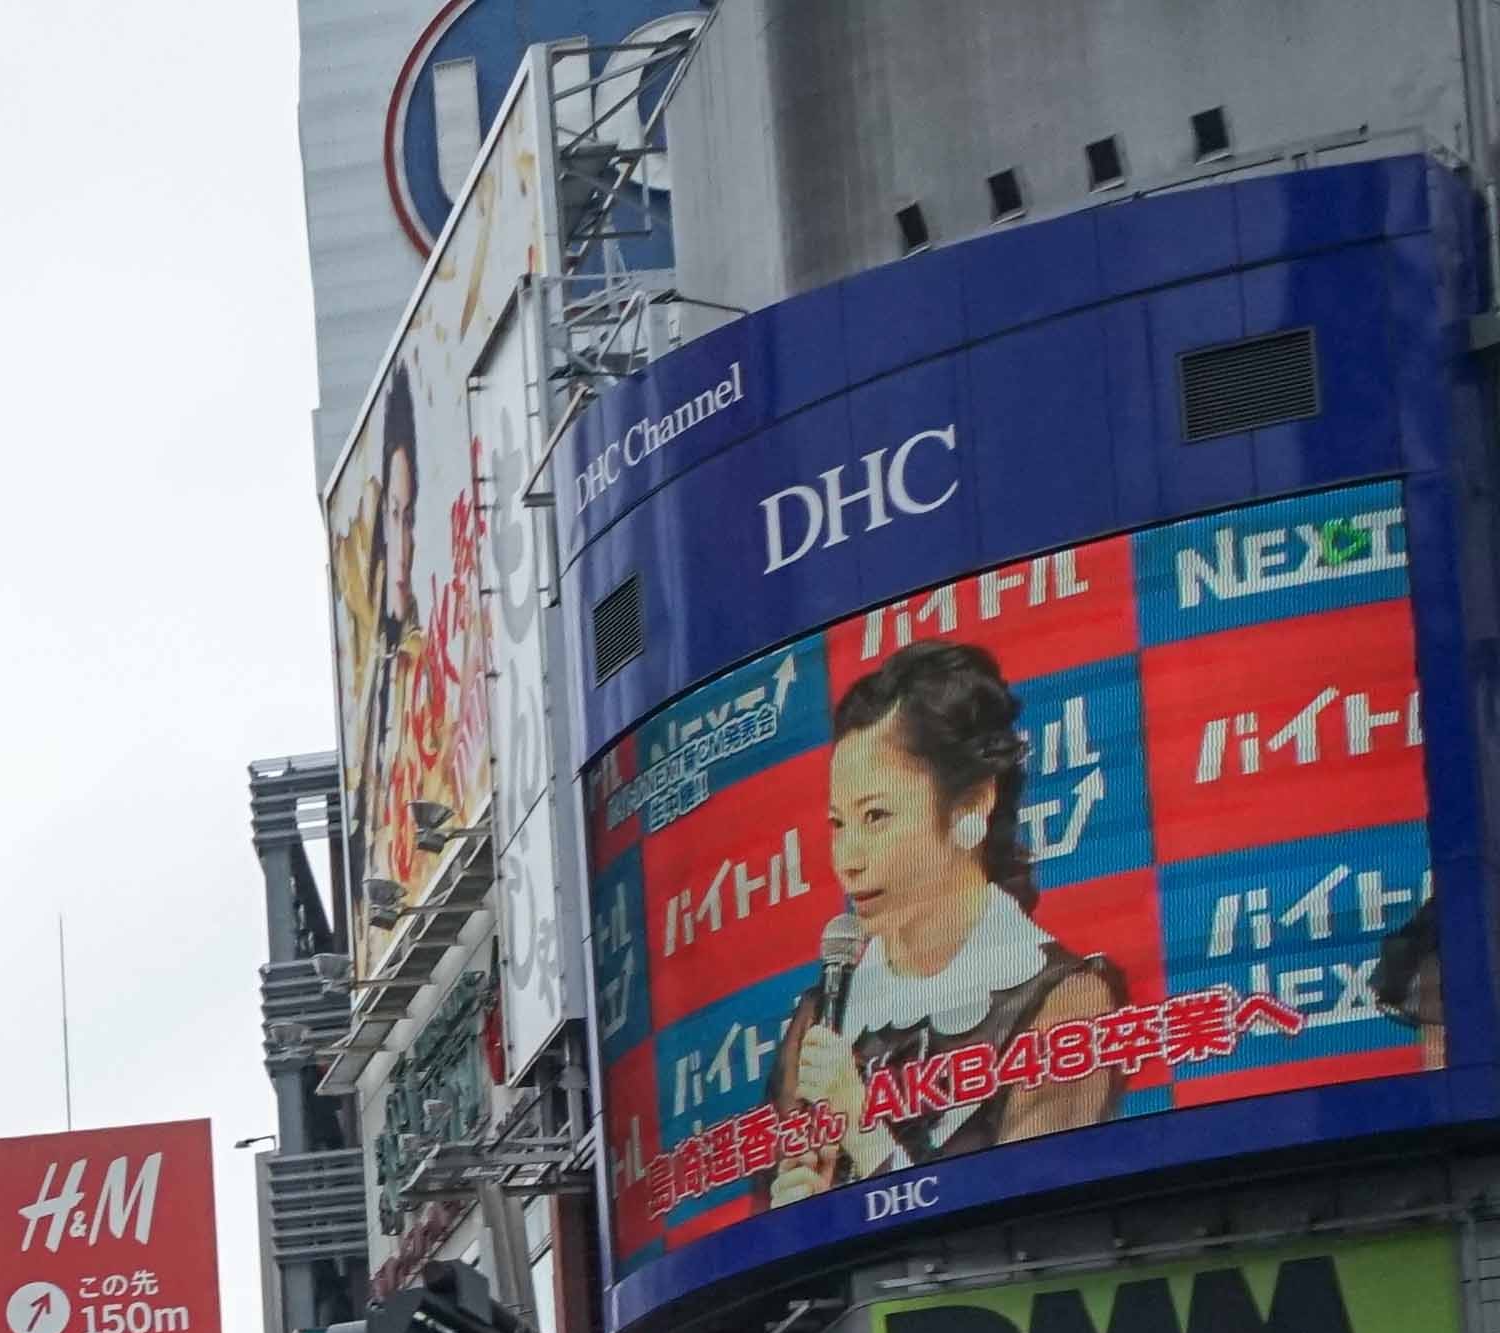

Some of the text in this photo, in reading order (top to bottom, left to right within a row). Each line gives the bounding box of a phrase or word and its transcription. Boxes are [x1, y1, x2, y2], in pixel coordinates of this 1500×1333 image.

[574, 363, 746, 517] DHC Channel
[758, 425, 959, 575] DHC
[664, 829, 810, 957] バイトル
[858, 983, 1306, 1136] AKB48卒業へ
[17, 1151, 164, 1254] H&M
[865, 1176, 941, 1222] DHC
[78, 1270, 160, 1299] この先
